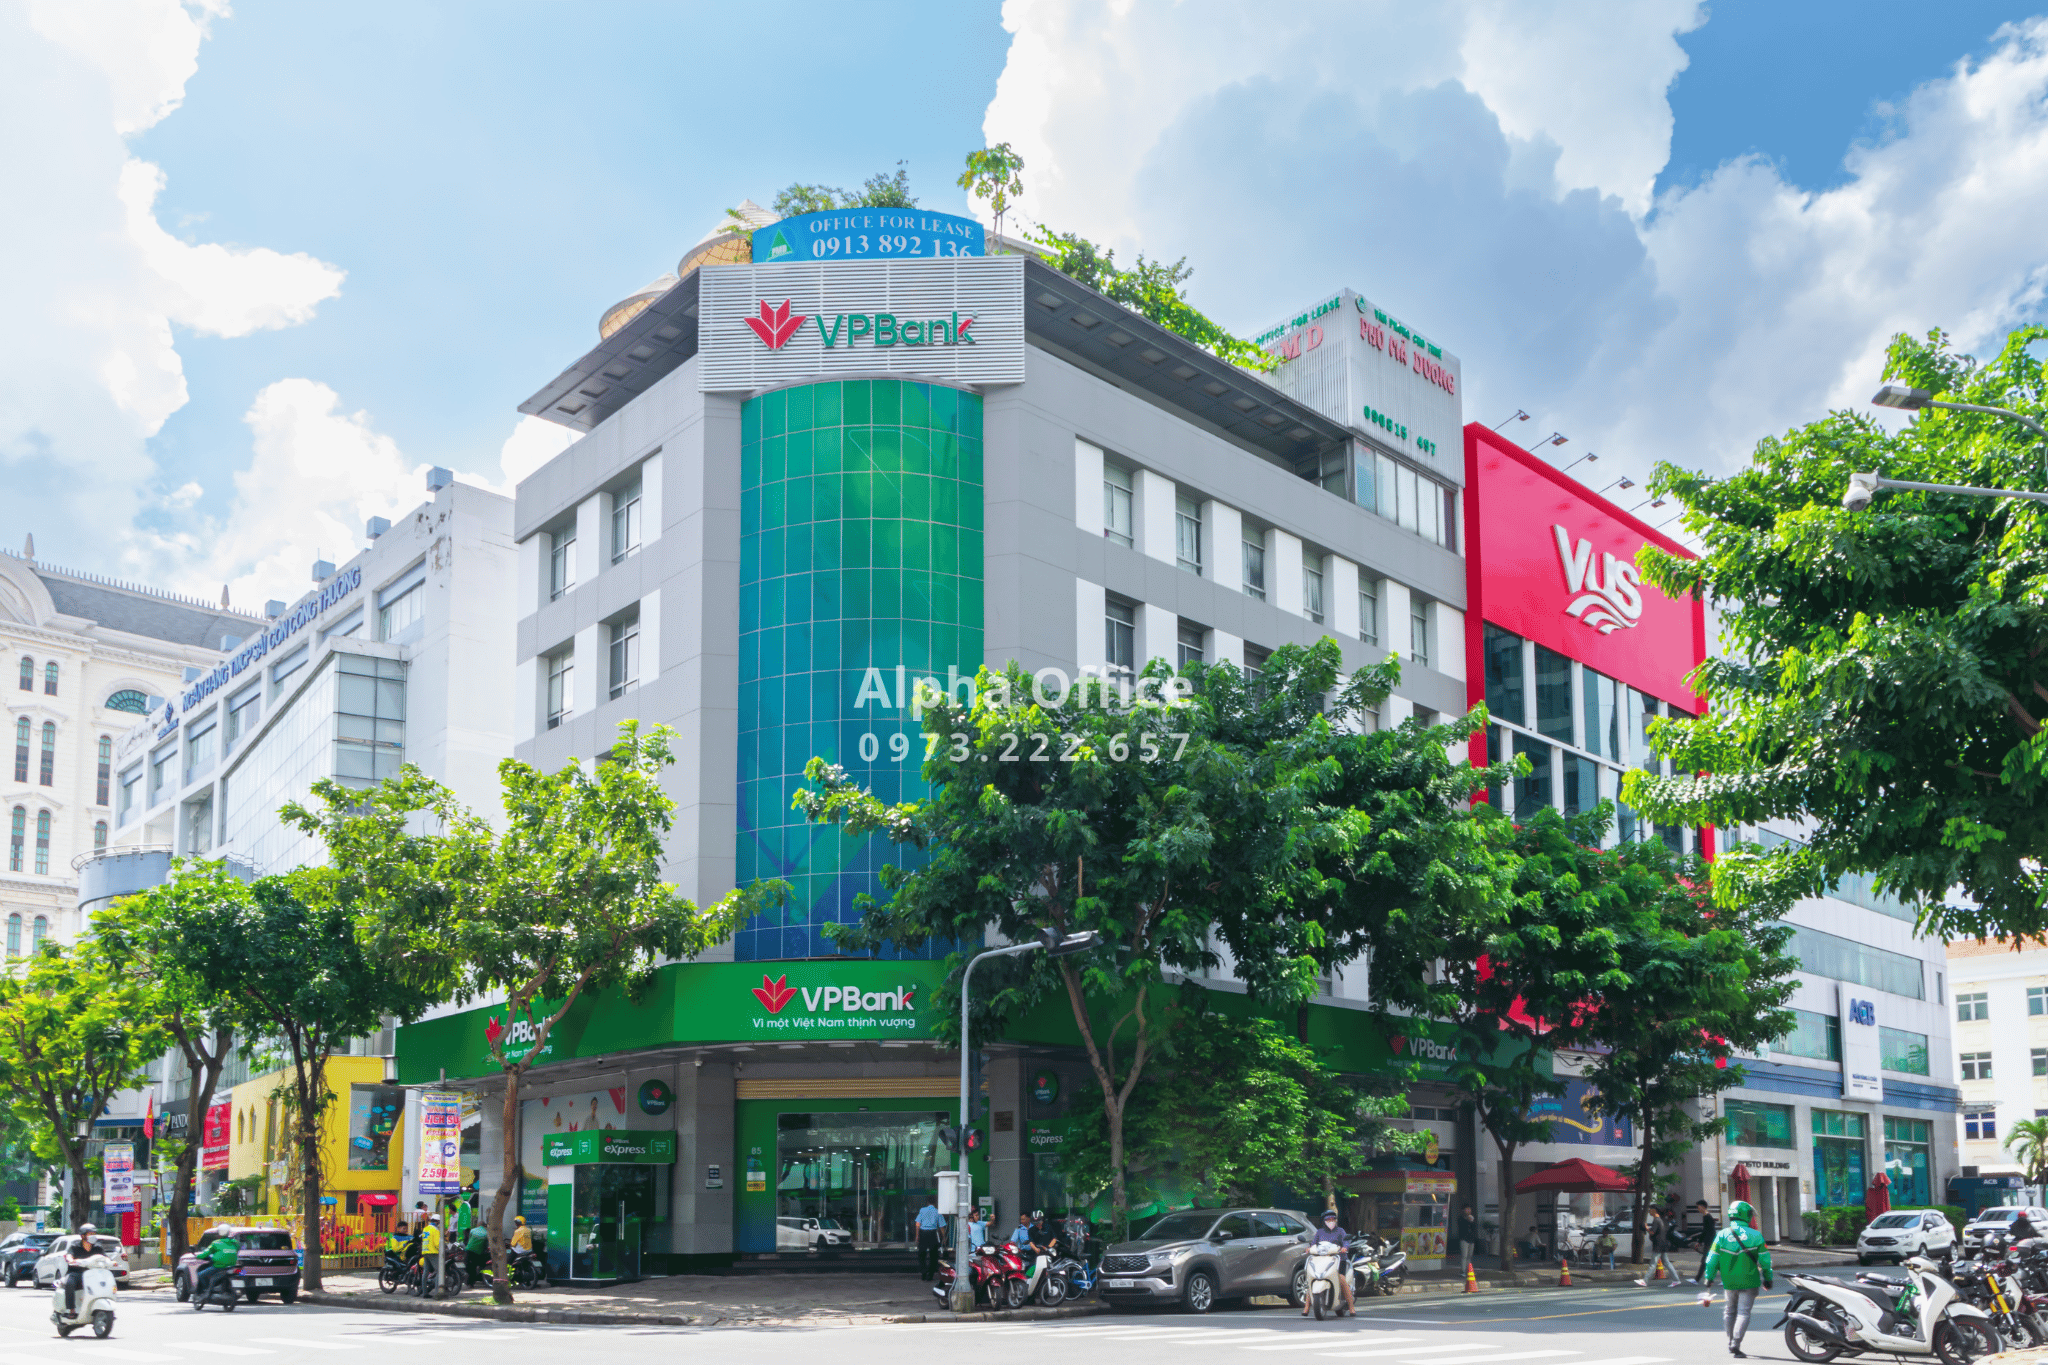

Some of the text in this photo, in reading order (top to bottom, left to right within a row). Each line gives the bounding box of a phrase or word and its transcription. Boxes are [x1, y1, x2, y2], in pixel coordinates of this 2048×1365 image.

[810, 215, 974, 240] OFFICE FOR LEASE
[812, 235, 973, 258] 0913 892 136
[1291, 313, 1308, 331] FOR
[1311, 296, 1340, 320] LEASE
[815, 311, 976, 349] VPBank
[1553, 523, 1642, 620] VUS
[801, 986, 914, 1012] VPBank
[753, 1017, 915, 1030] Vì một Việt Nam thịnh vượng
[1849, 998, 1876, 1027] ACB
[1409, 1037, 1458, 1060] VPBank
[171, 1114, 190, 1129] PAND
[604, 1145, 646, 1156] eXpress
[1031, 1135, 1063, 1146] eXpress
[550, 1148, 573, 1158] eXpress
